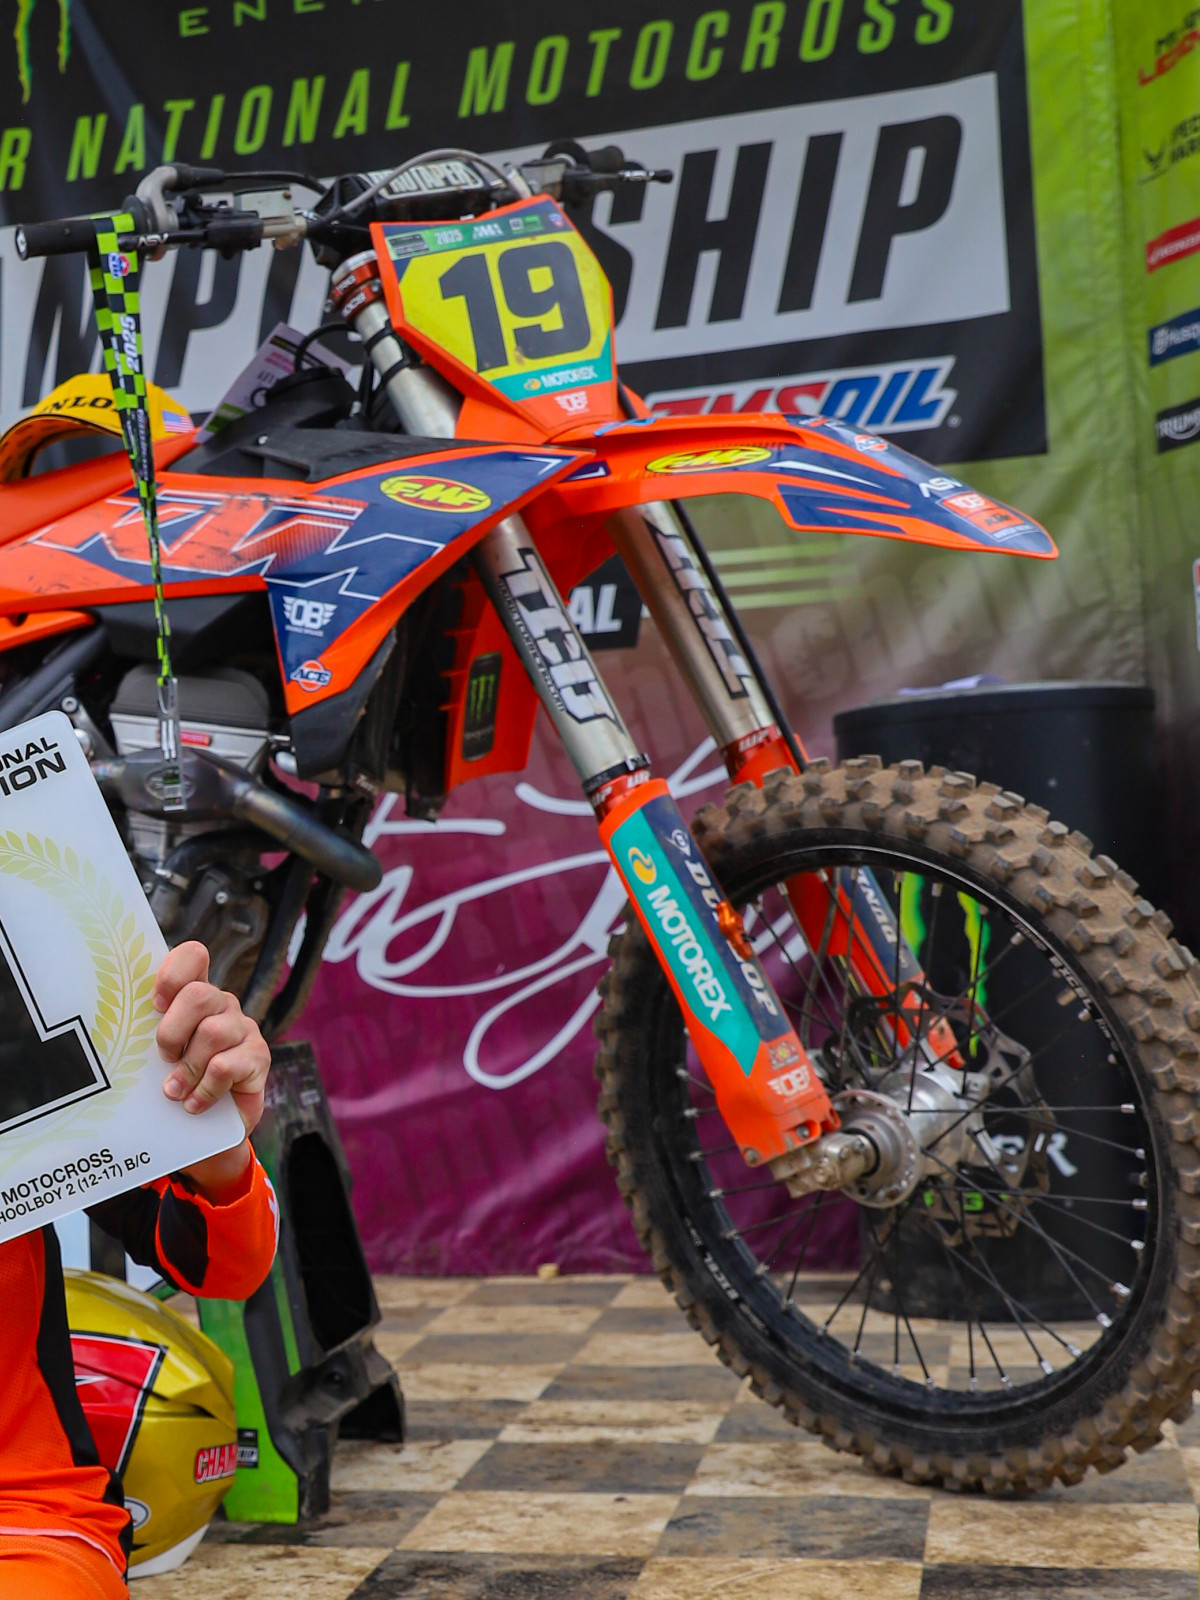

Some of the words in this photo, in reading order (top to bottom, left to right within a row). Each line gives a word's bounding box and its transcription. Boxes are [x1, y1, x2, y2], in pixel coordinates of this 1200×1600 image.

[66, 61, 410, 183] NATIONAL
[458, 0, 954, 118] MOTOCROSS
[438, 240, 592, 374] 19
[119, 315, 140, 373] 2025
[539, 364, 599, 389] MOTOREX
[386, 482, 487, 510] FMF
[646, 884, 732, 1023] MOTOREX
[0, 1148, 115, 1206] MOTOCROSS
[65, 1183, 77, 1196] 2
[77, 1163, 124, 1194] (12-17)
[123, 1151, 152, 1172] B/C
